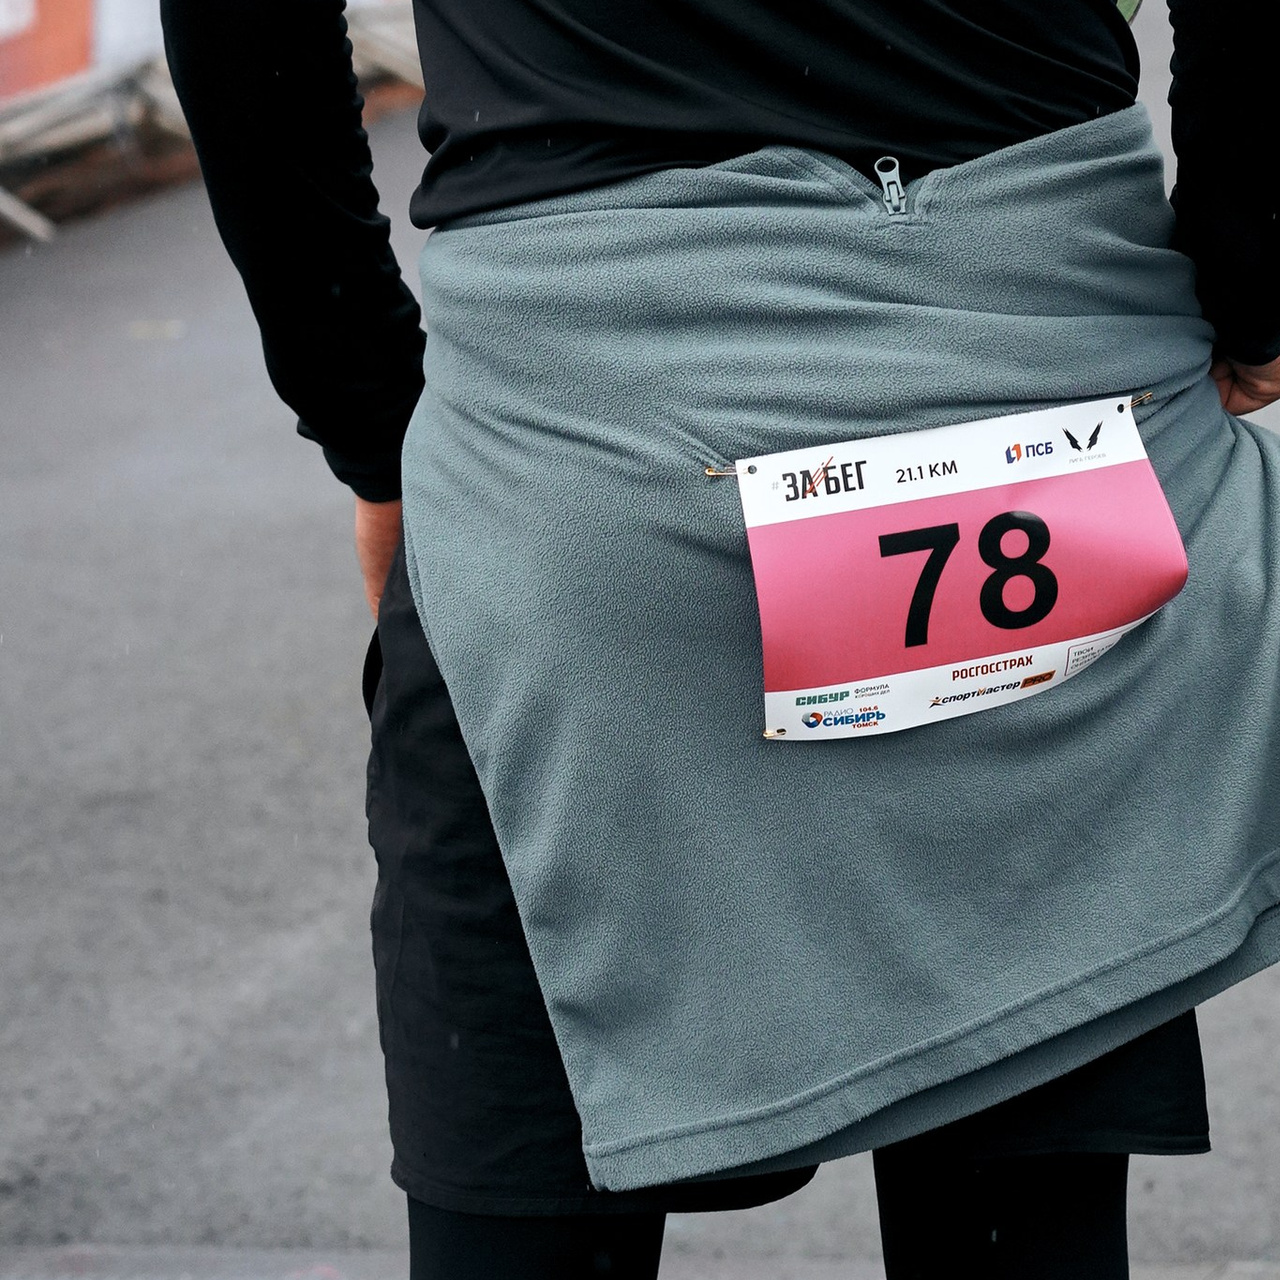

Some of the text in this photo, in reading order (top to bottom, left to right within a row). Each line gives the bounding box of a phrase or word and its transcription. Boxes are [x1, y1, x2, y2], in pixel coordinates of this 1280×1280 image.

[1025, 441, 1054, 458] ПСБ
[896, 460, 958, 483] 21.1 КМ
[878, 511, 1058, 648] 78
[952, 655, 1033, 681] РОСГОССТРАХ
[854, 684, 889, 694] ФОРМУЛА
[796, 691, 850, 706] СИБУР
[823, 710, 886, 727] СИБИРЬ
[824, 708, 854, 717] РАДИО
[852, 721, 878, 729] ТОМСК
